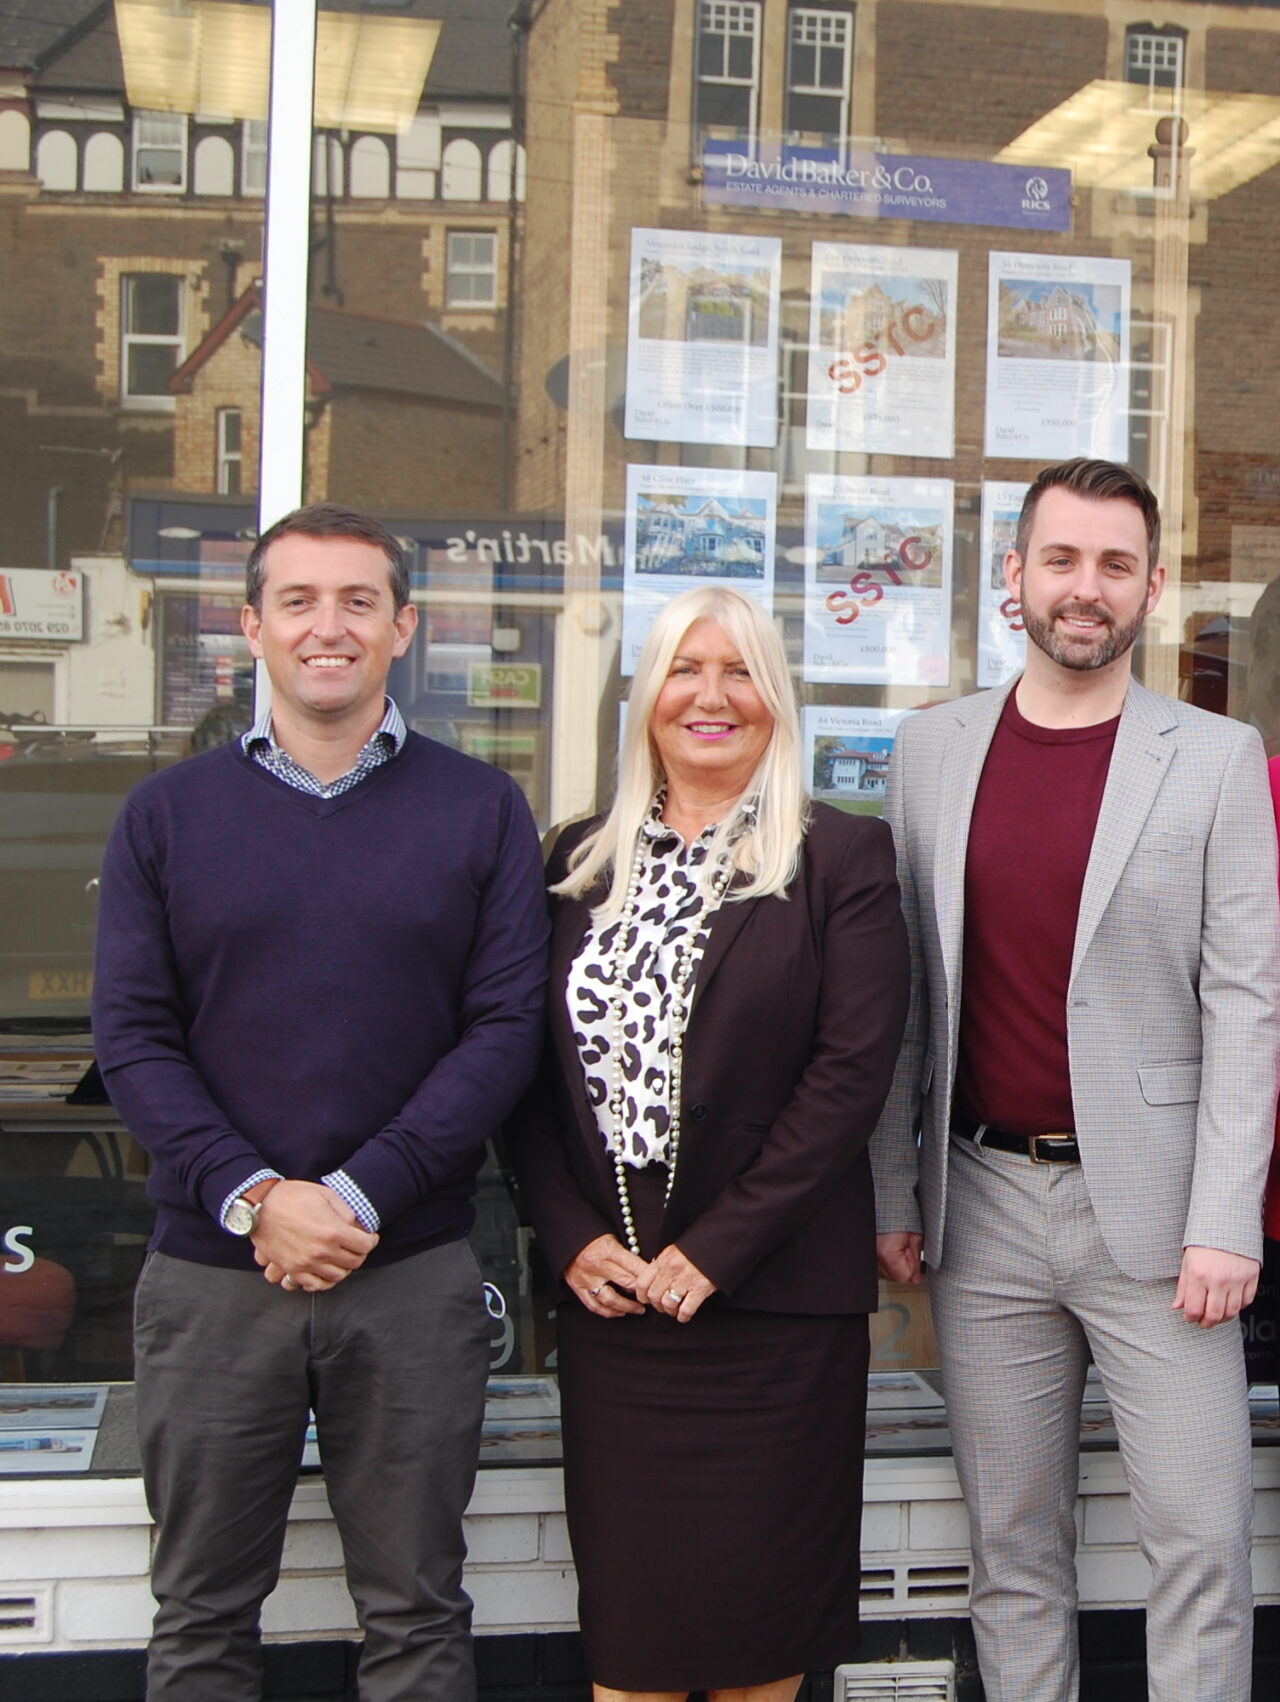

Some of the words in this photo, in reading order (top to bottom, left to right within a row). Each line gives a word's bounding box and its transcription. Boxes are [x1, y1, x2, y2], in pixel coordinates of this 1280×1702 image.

[726, 181, 763, 194] ESTATE
[764, 184, 807, 197] AGENTS
[809, 189, 816, 198] &
[818, 188, 882, 203] CHARTERED
[883, 194, 947, 209] SURVEYORS
[1021, 200, 1051, 211] RICS
[828, 306, 936, 394] SSTC
[825, 536, 932, 626] SSTC
[862, 718, 882, 727] Road
